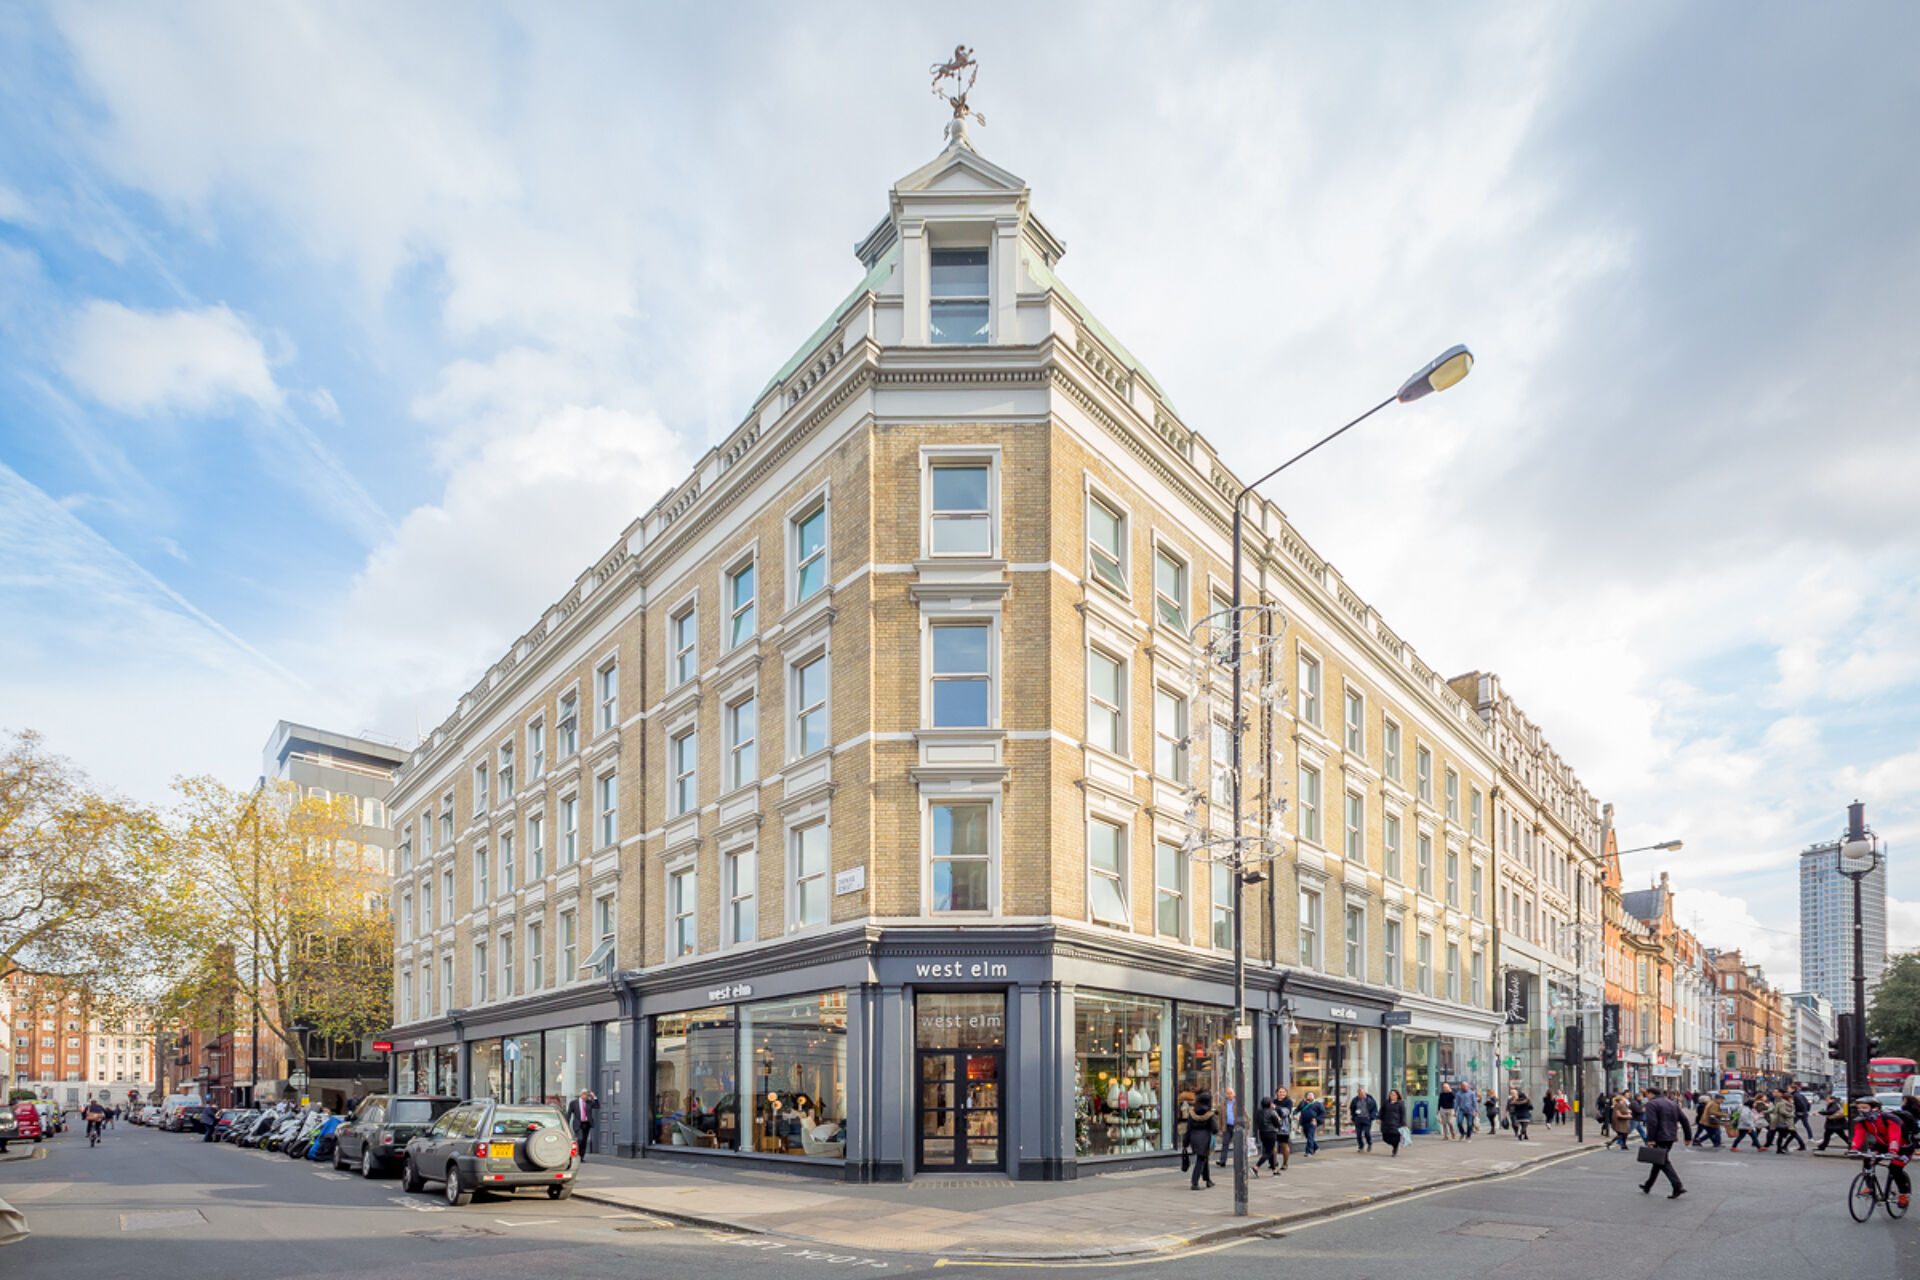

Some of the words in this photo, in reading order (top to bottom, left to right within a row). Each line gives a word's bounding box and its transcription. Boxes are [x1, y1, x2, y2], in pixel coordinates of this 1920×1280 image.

[916, 961, 962, 977] west
[971, 961, 1007, 977] elm
[708, 986, 731, 1001] west
[921, 1014, 962, 1028] west
[969, 1014, 1001, 1028] elm
